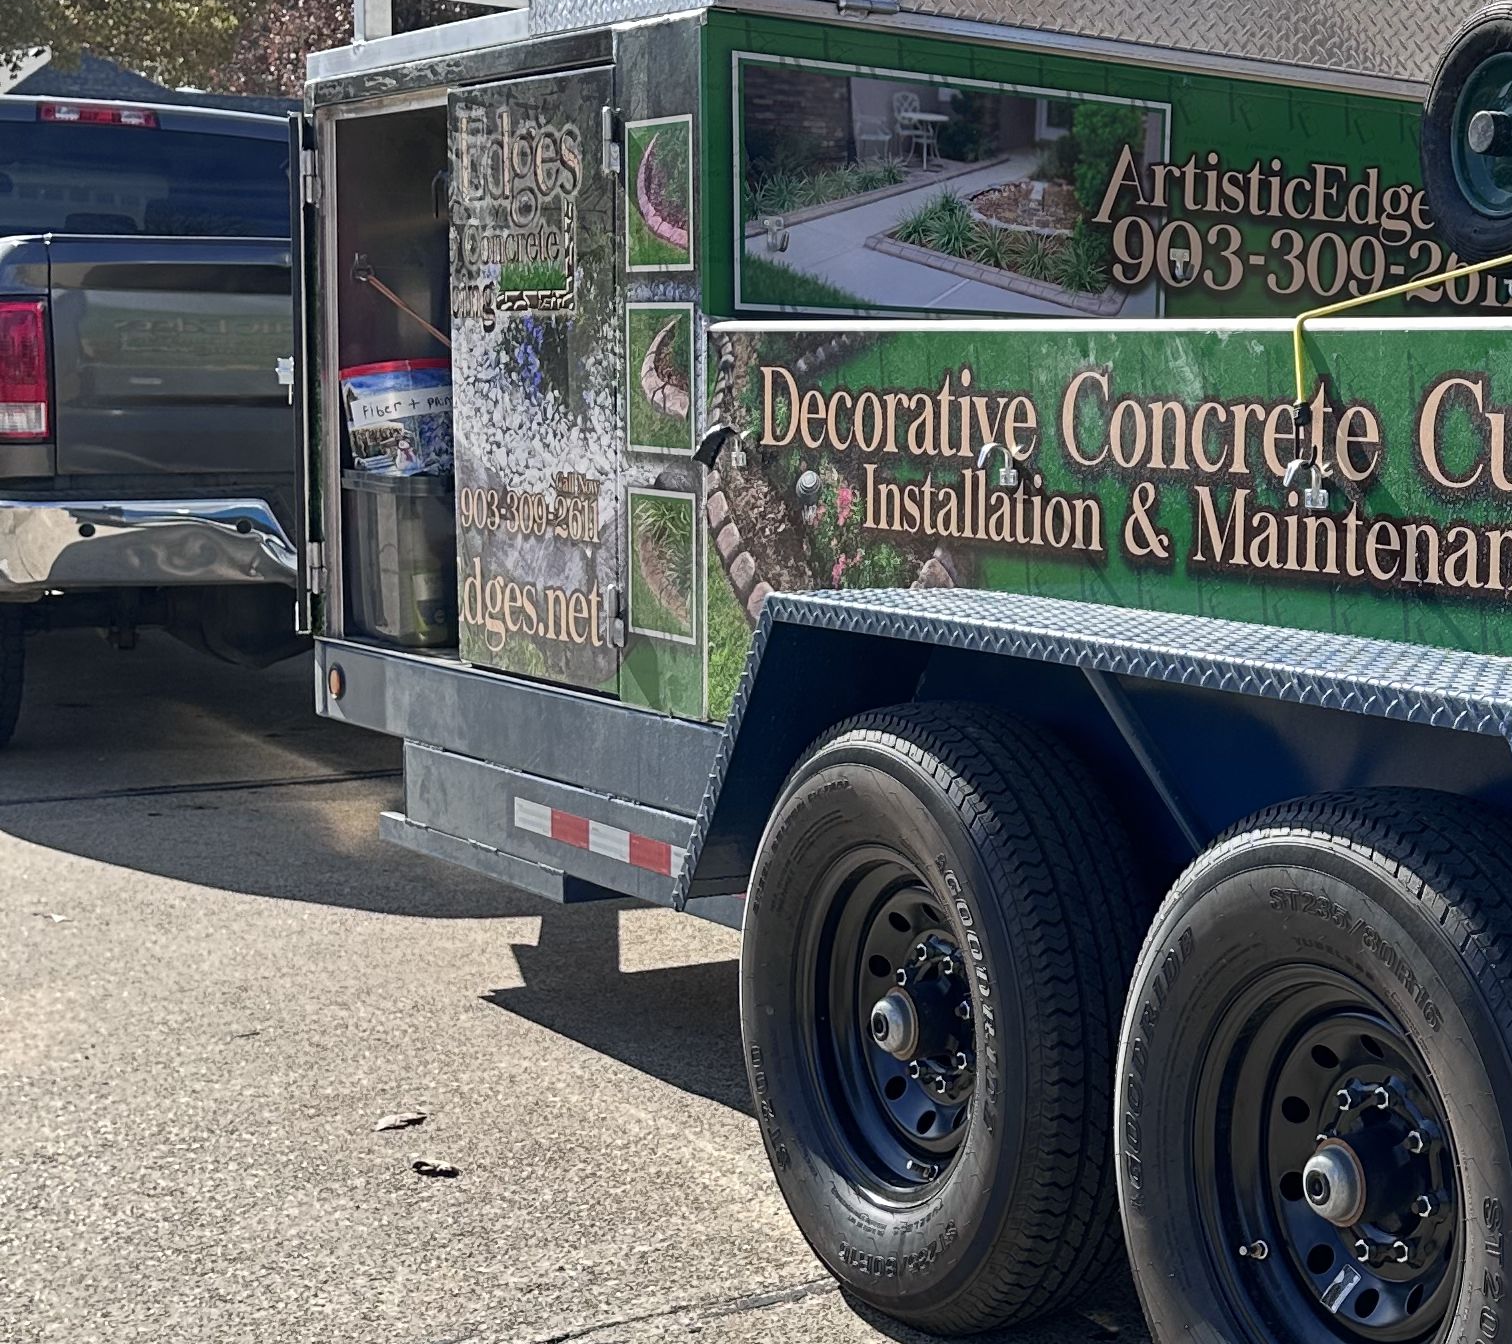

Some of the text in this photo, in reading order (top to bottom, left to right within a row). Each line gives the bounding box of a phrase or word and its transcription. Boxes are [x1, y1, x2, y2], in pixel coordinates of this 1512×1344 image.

[460, 111, 581, 227] Edges
[463, 225, 560, 266] Concrete
[760, 367, 1037, 461] Decorative
[1062, 371, 1380, 481] Concrete
[460, 487, 600, 542] 903-309-2611
[556, 471, 599, 494] Call Now
[863, 464, 1103, 551] Installation
[1125, 482, 1169, 557] &
[459, 557, 603, 652] dges.net
